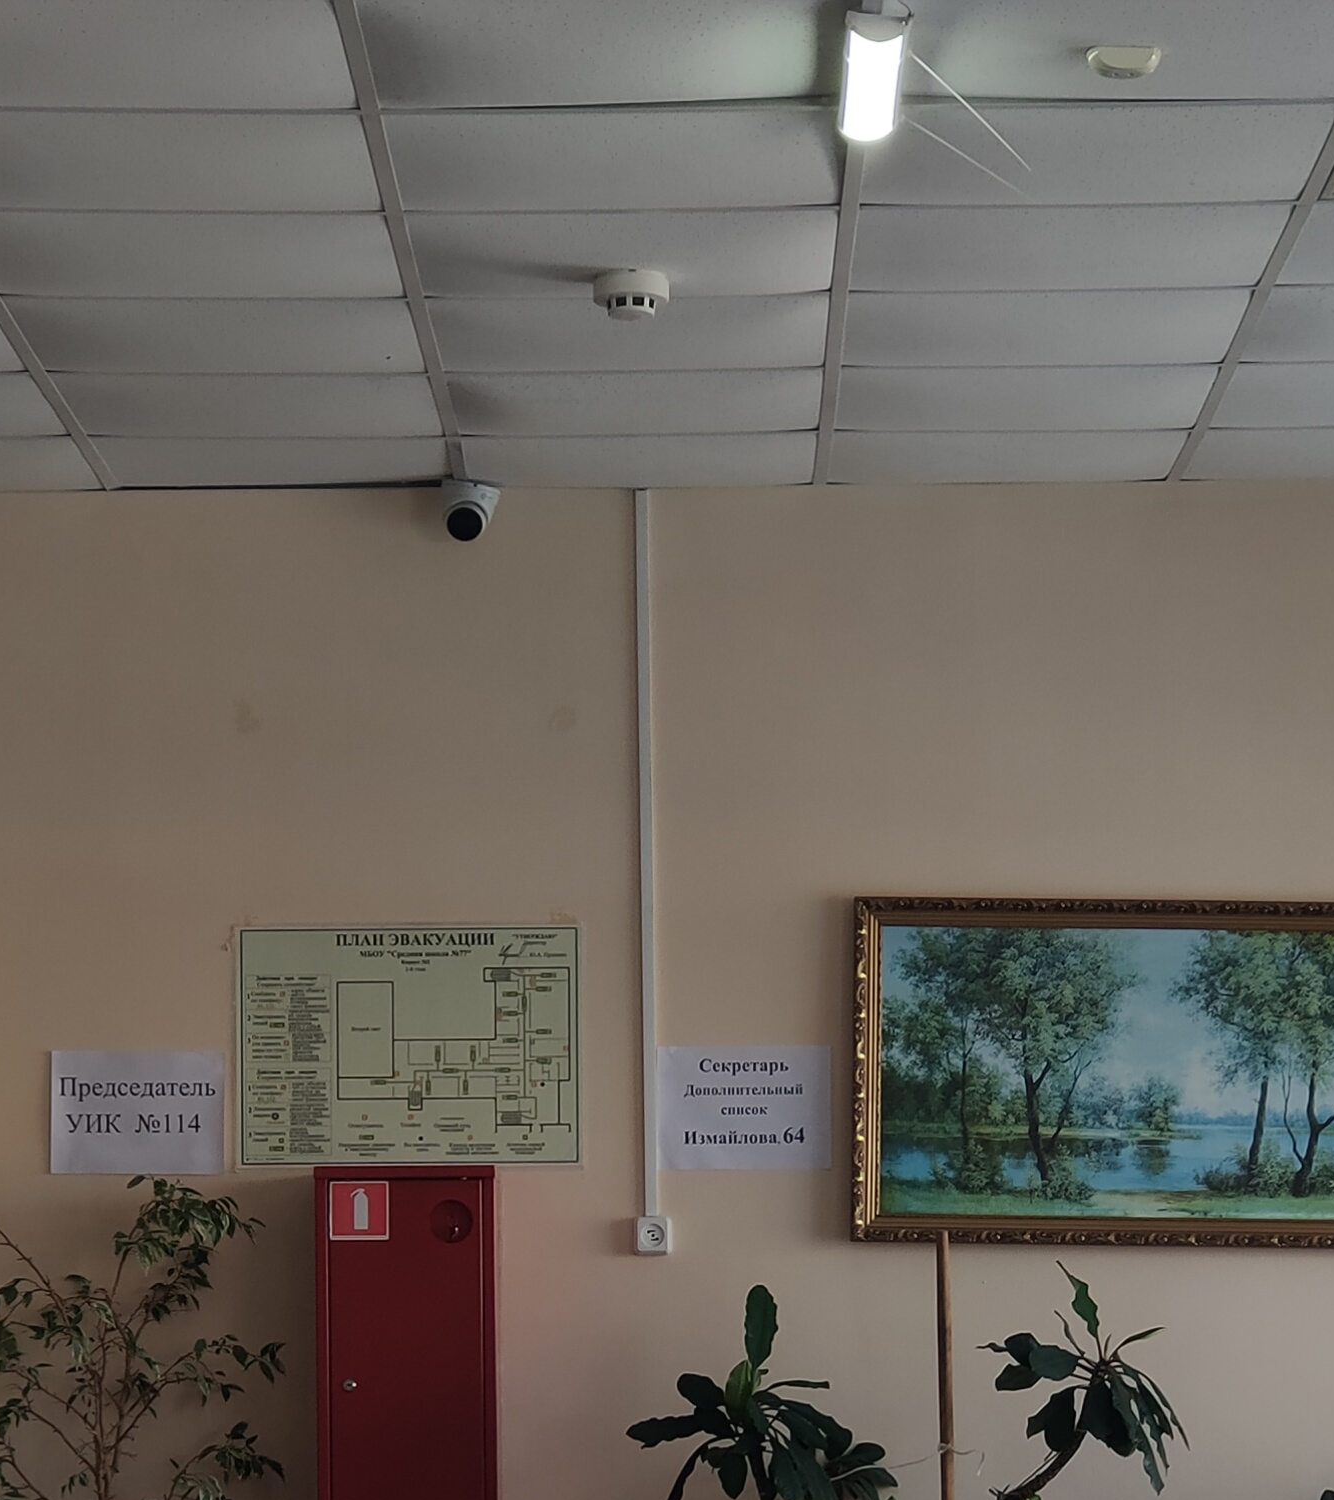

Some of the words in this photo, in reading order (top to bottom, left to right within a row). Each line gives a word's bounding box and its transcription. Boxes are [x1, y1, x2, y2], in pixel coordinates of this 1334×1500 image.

[336, 933, 384, 947] ПЛАН
[388, 932, 495, 948] ЭВАКУАЦИИ
[698, 1057, 789, 1076] Секретарь
[59, 1076, 216, 1103] Председатель
[683, 1083, 803, 1098] Дополнительный
[720, 1105, 768, 1116] список
[65, 1113, 122, 1134] УИК
[134, 1113, 201, 1134] №114
[783, 1126, 805, 1144] 64
